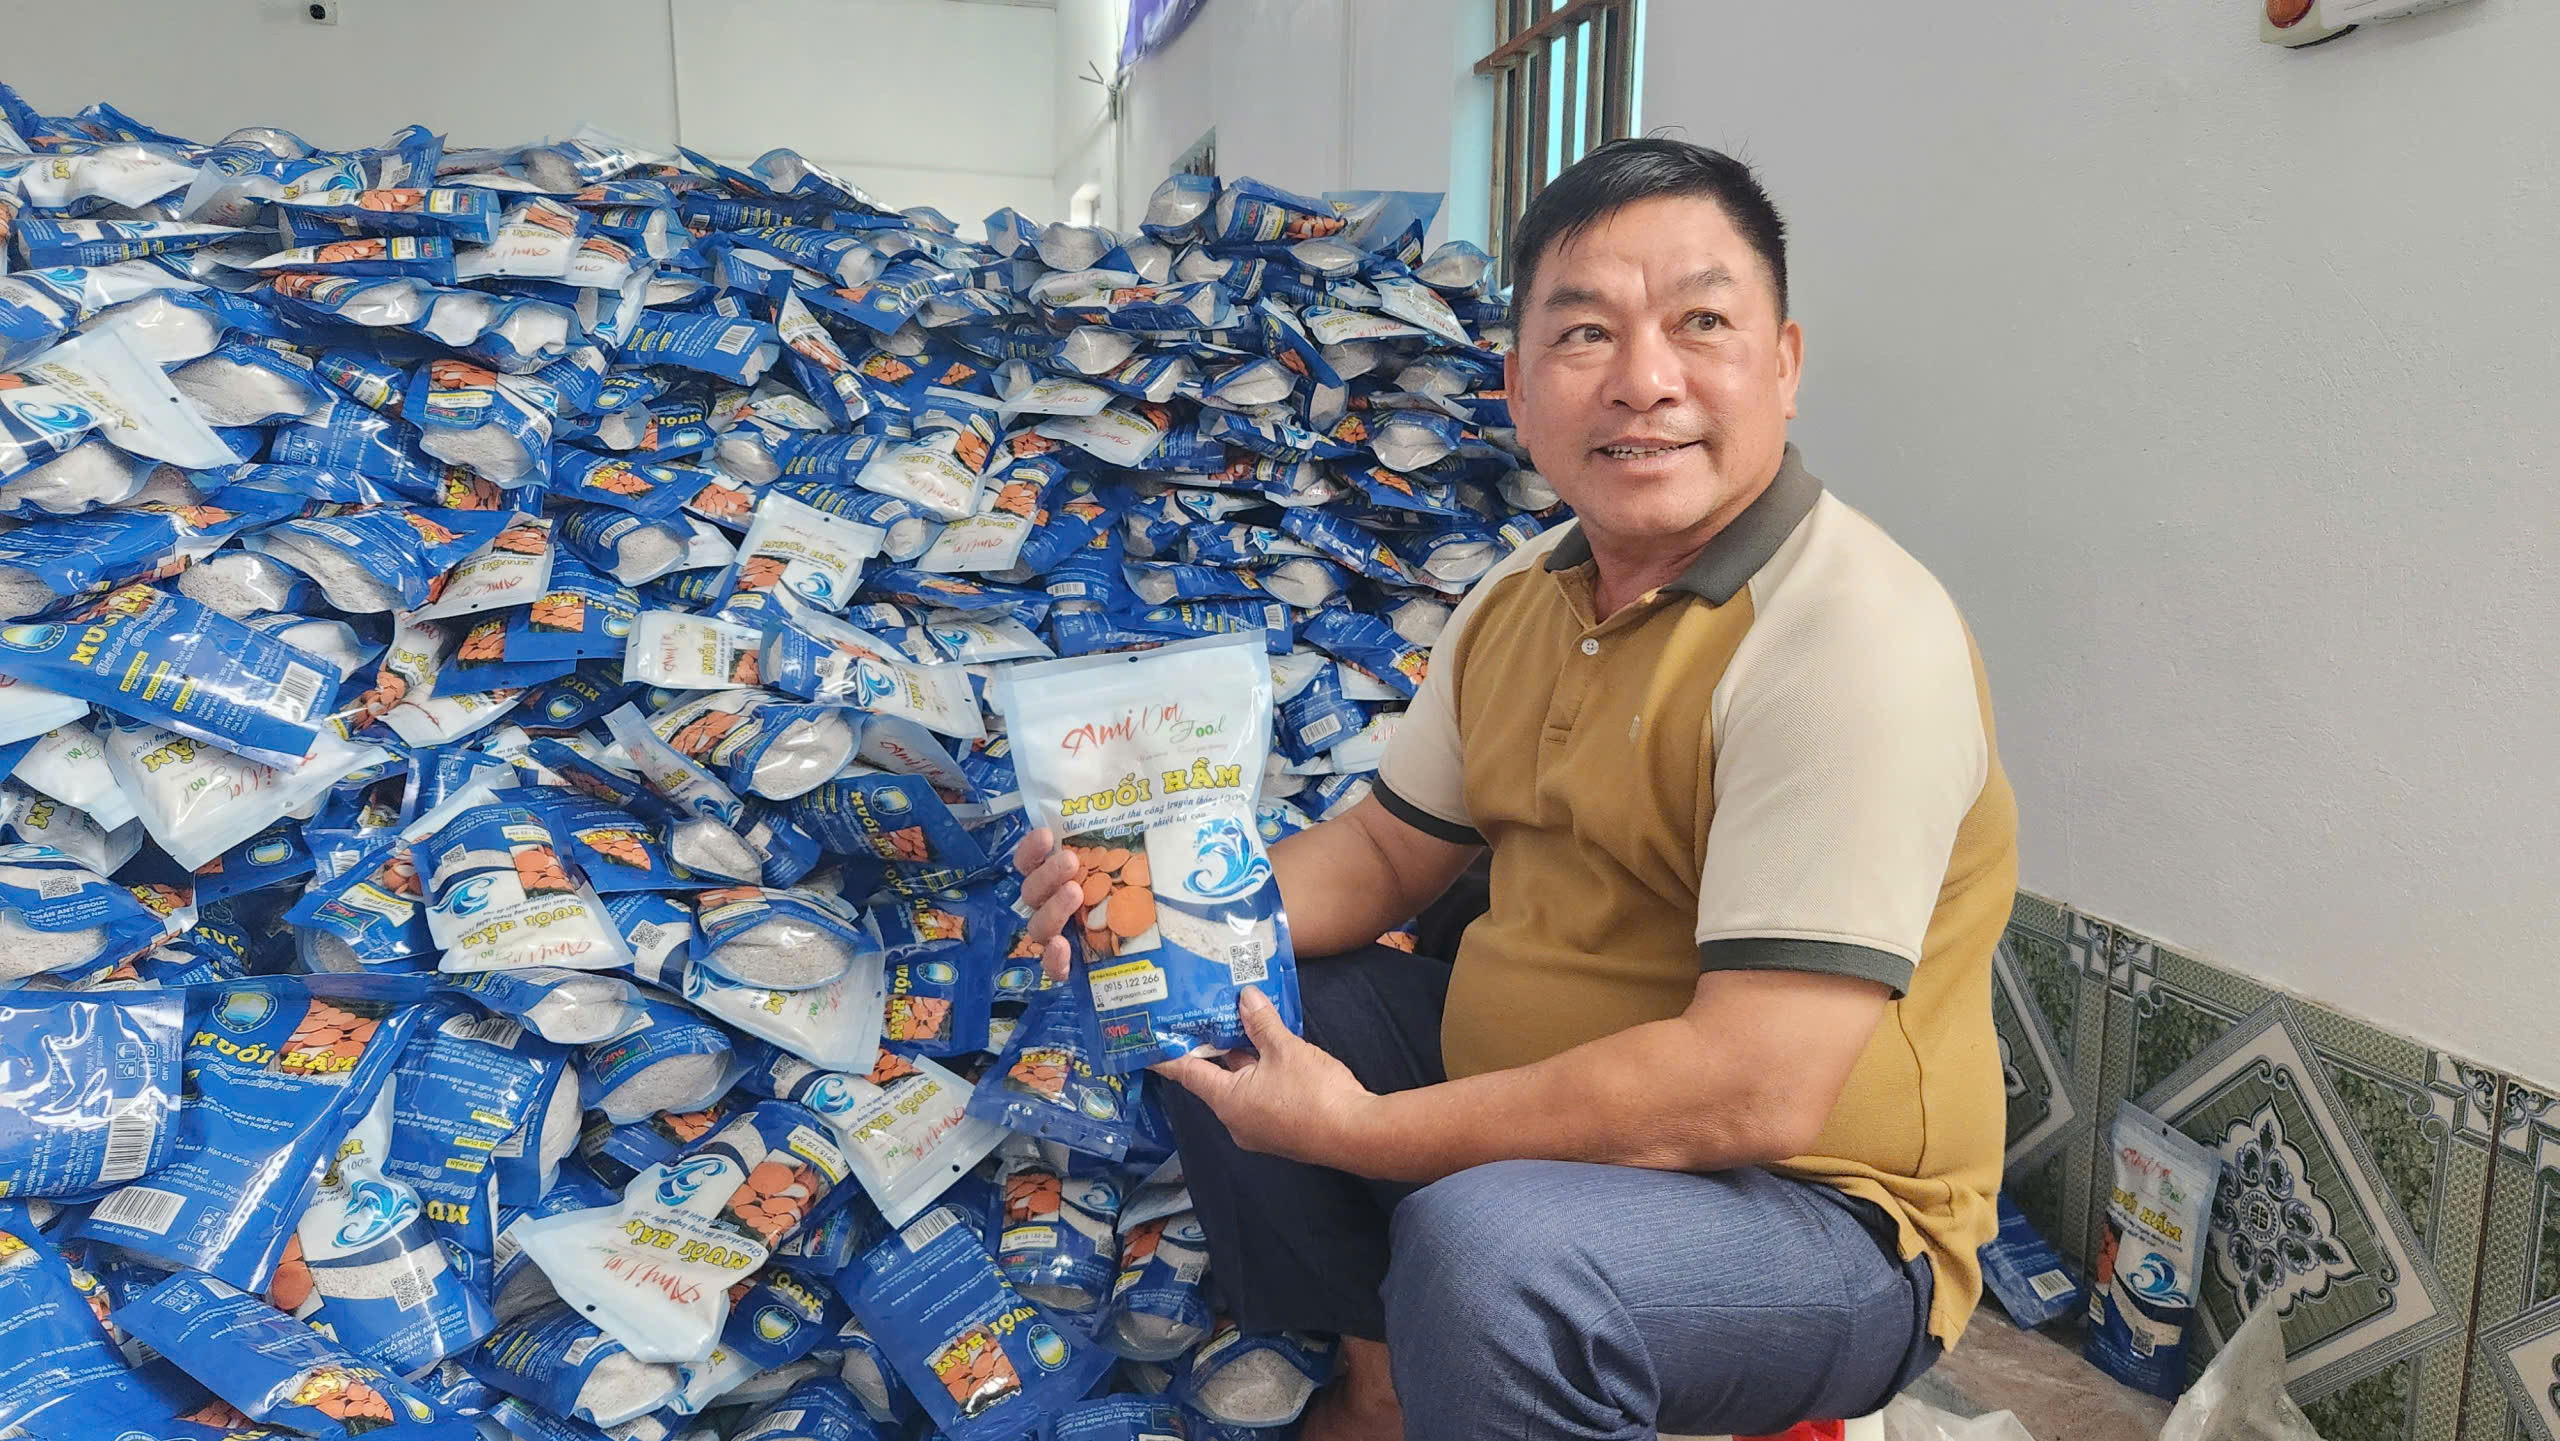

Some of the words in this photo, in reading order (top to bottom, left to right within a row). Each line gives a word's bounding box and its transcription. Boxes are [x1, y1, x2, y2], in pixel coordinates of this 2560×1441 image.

[657, 409, 703, 430] MUỐI
[698, 643, 716, 675] MUỐI
[1169, 714, 1226, 744] Food
[1061, 772, 1152, 816] MUỐI
[1162, 757, 1241, 794] HẦM
[849, 787, 883, 838] MUỐI
[1063, 817, 1086, 832] Muối
[1088, 816, 1108, 829] phơi
[1145, 805, 1165, 817] công
[57, 906, 76, 916] ANT
[77, 899, 109, 911] GROUP
[1104, 981, 1123, 992] 0915
[1125, 977, 1139, 988] 122
[1142, 973, 1160, 985] 266
[889, 1000, 911, 1040] HẦM
[1171, 1020, 1196, 1030] CÔNG
[1210, 1012, 1222, 1022] CỔ
[189, 1029, 277, 1067] MUỐI
[280, 1045, 359, 1074] HẦM
[159, 1064, 170, 1081] GNY:
[893, 1079, 944, 1122] MUỐI
[792, 1131, 807, 1145] 266
[805, 1139, 820, 1152] 122
[31, 1152, 40, 1166] 900
[206, 1147, 223, 1159] Hạn
[221, 1152, 234, 1162] sử
[232, 1155, 253, 1168] dụng:
[818, 1149, 837, 1165] 0915
[197, 1166, 210, 1176] Lợi
[211, 1180, 226, 1190] Tỉnh
[426, 1199, 470, 1225] MU
[123, 1229, 136, 1238] Việt
[135, 1232, 150, 1241] Nam
[176, 1242, 198, 1255] GNY:
[673, 1237, 753, 1271] MUỐI
[382, 1340, 399, 1355] CỔ
[396, 1328, 423, 1347] PHẦN
[438, 1310, 465, 1326] GROUP
[931, 1333, 986, 1376] HẦM
